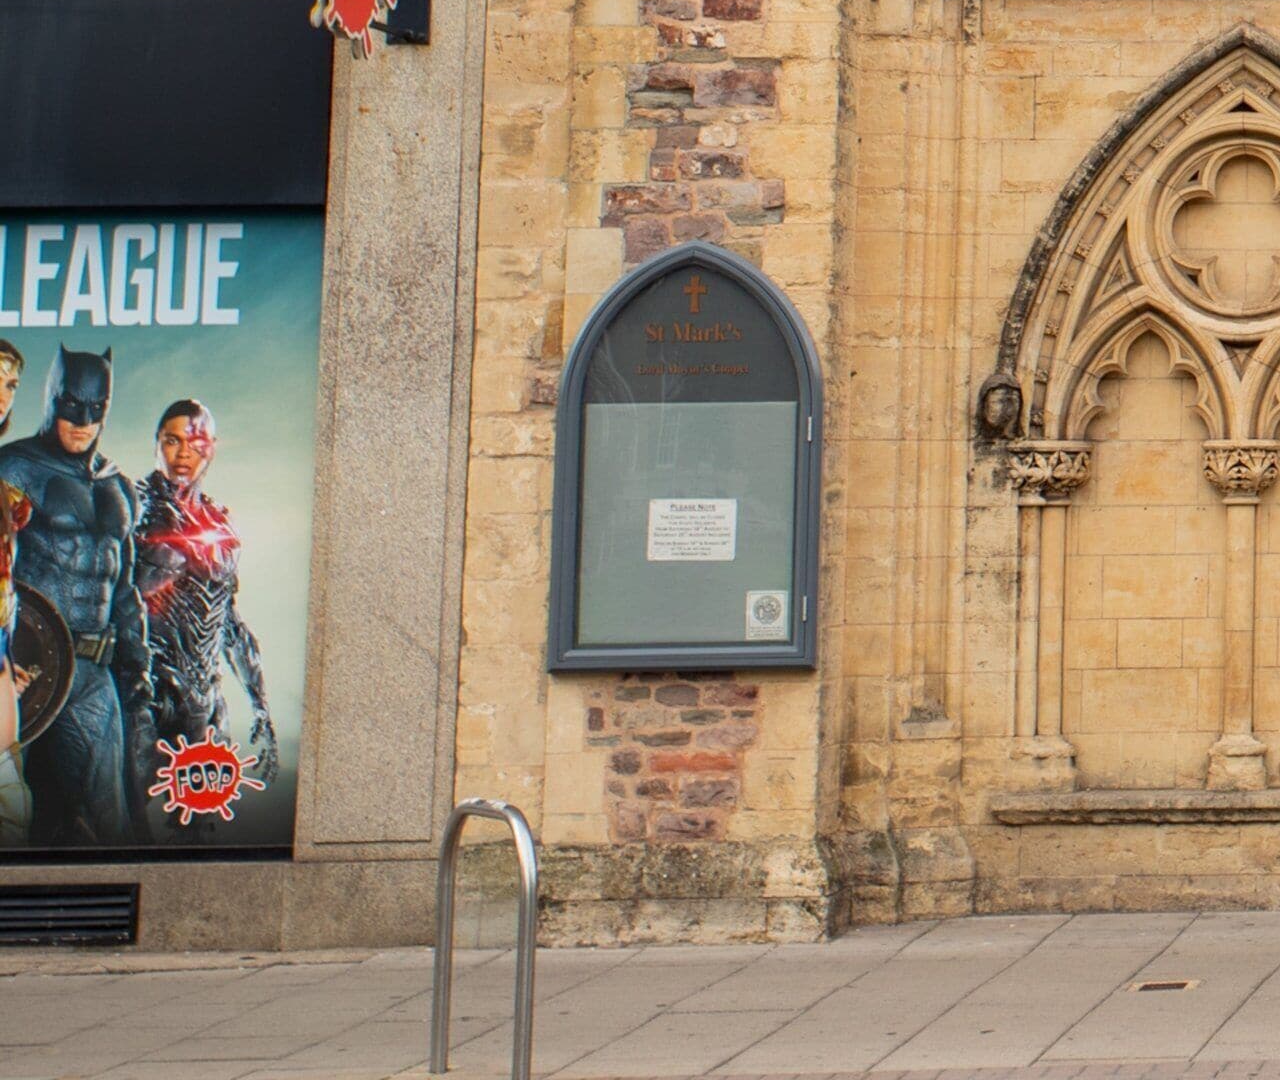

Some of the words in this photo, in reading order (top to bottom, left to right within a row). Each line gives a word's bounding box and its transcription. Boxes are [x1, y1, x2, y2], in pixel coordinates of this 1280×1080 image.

[645, 323, 665, 343] St
[671, 321, 743, 343] Mark's
[175, 759, 236, 798] FOPP
